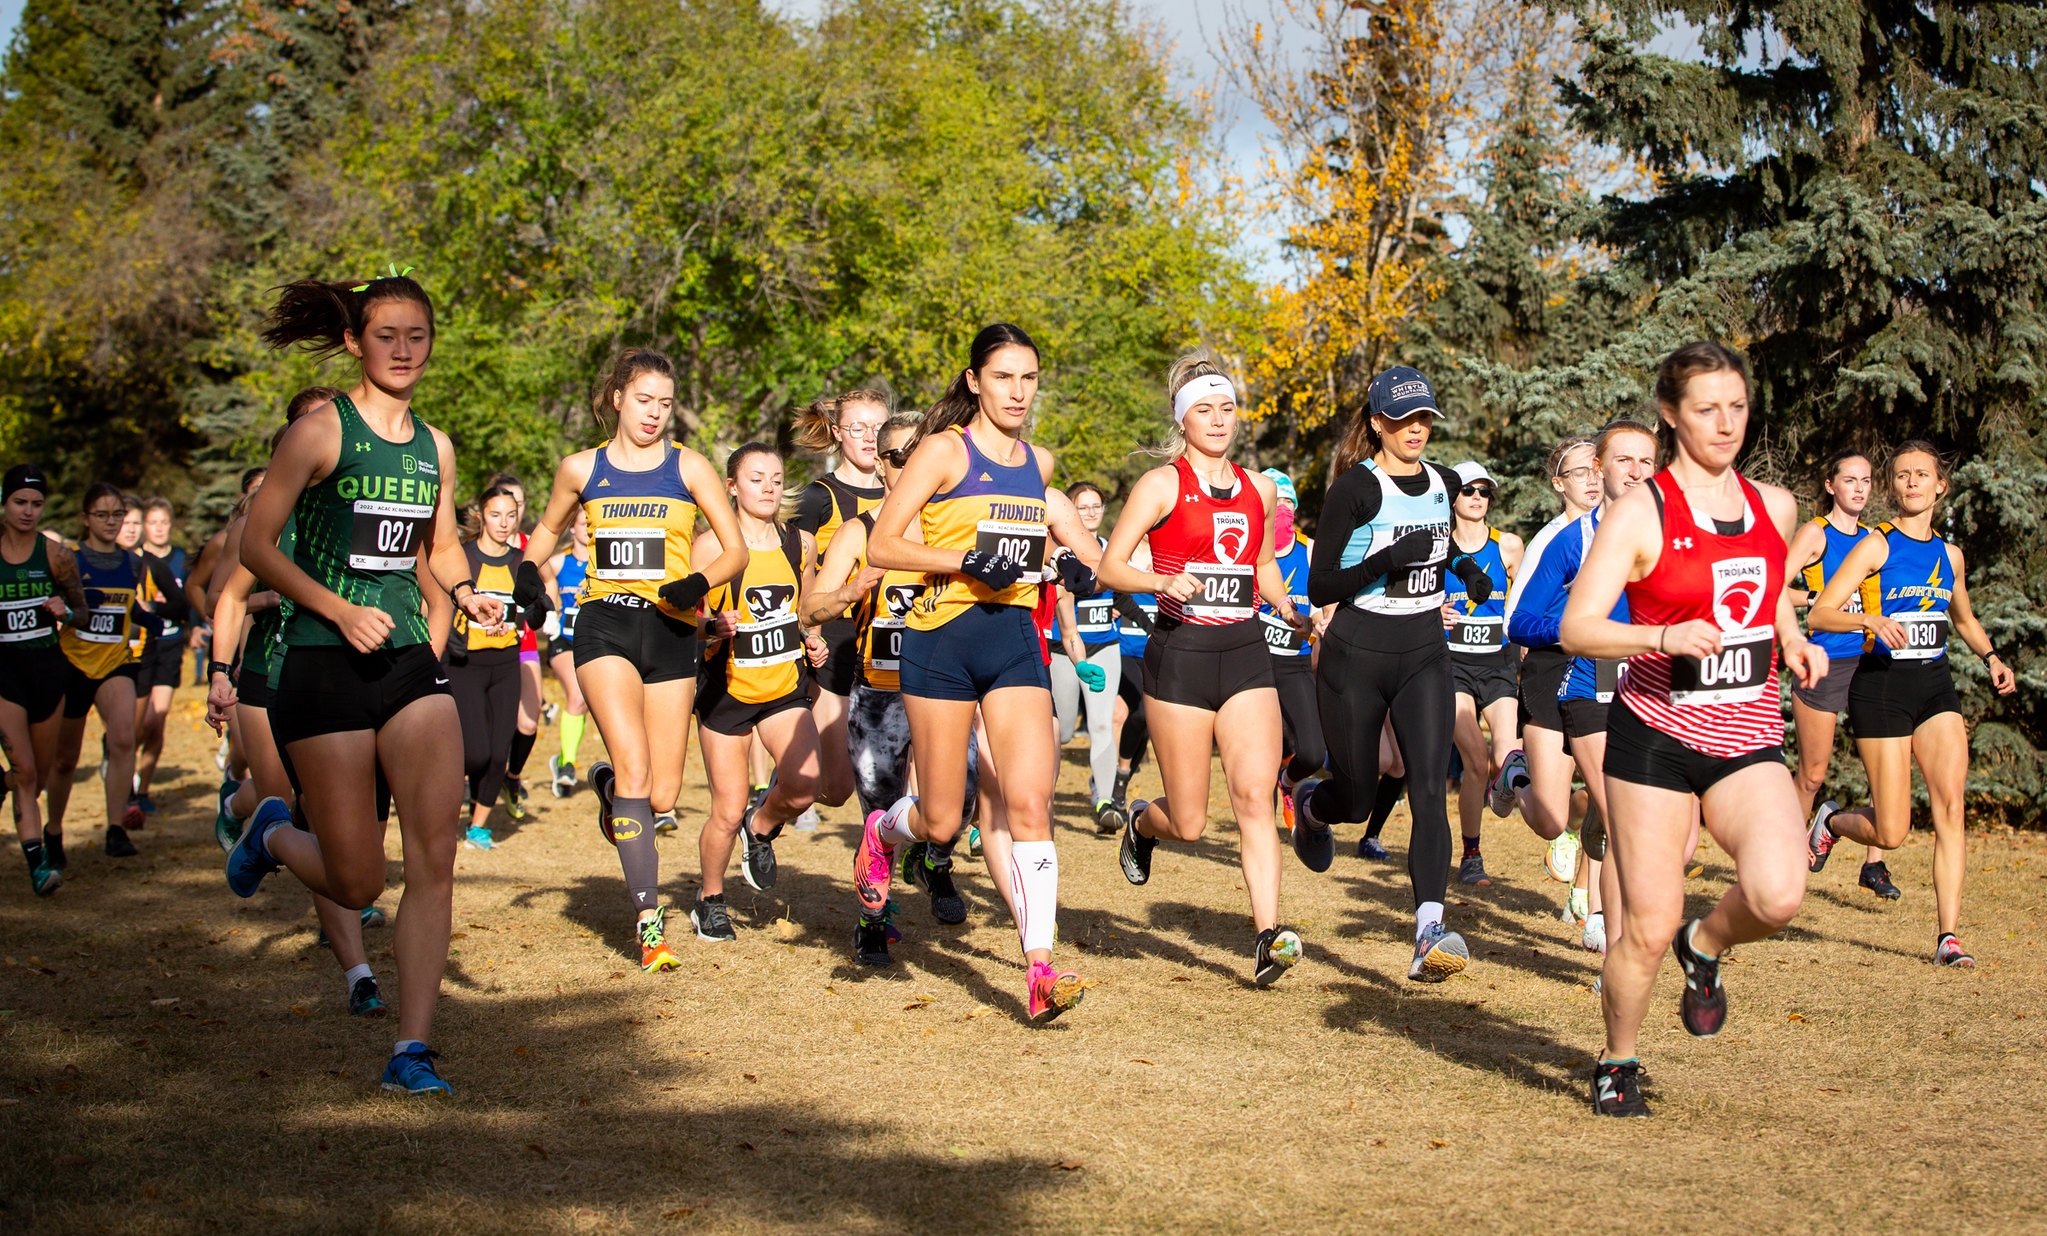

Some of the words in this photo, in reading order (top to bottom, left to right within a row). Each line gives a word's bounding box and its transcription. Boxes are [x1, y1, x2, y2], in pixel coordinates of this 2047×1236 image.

[337, 476, 439, 506] QUEENS
[602, 503, 668, 518] THUNDER
[1216, 517, 1245, 525] TROJANS
[377, 520, 414, 552] 021
[610, 541, 644, 565] 001
[997, 537, 1031, 566] 002
[1407, 566, 1437, 594] 005
[1718, 565, 1761, 579] TROJANS
[1204, 577, 1240, 603] 042
[7, 609, 37, 631] 023
[89, 614, 114, 633] 003
[1089, 607, 1108, 623] 045
[752, 628, 785, 655] 010
[1264, 625, 1292, 647] 034
[1463, 625, 1490, 644] 032
[1908, 623, 1937, 646] 030
[1700, 648, 1751, 685] 040
